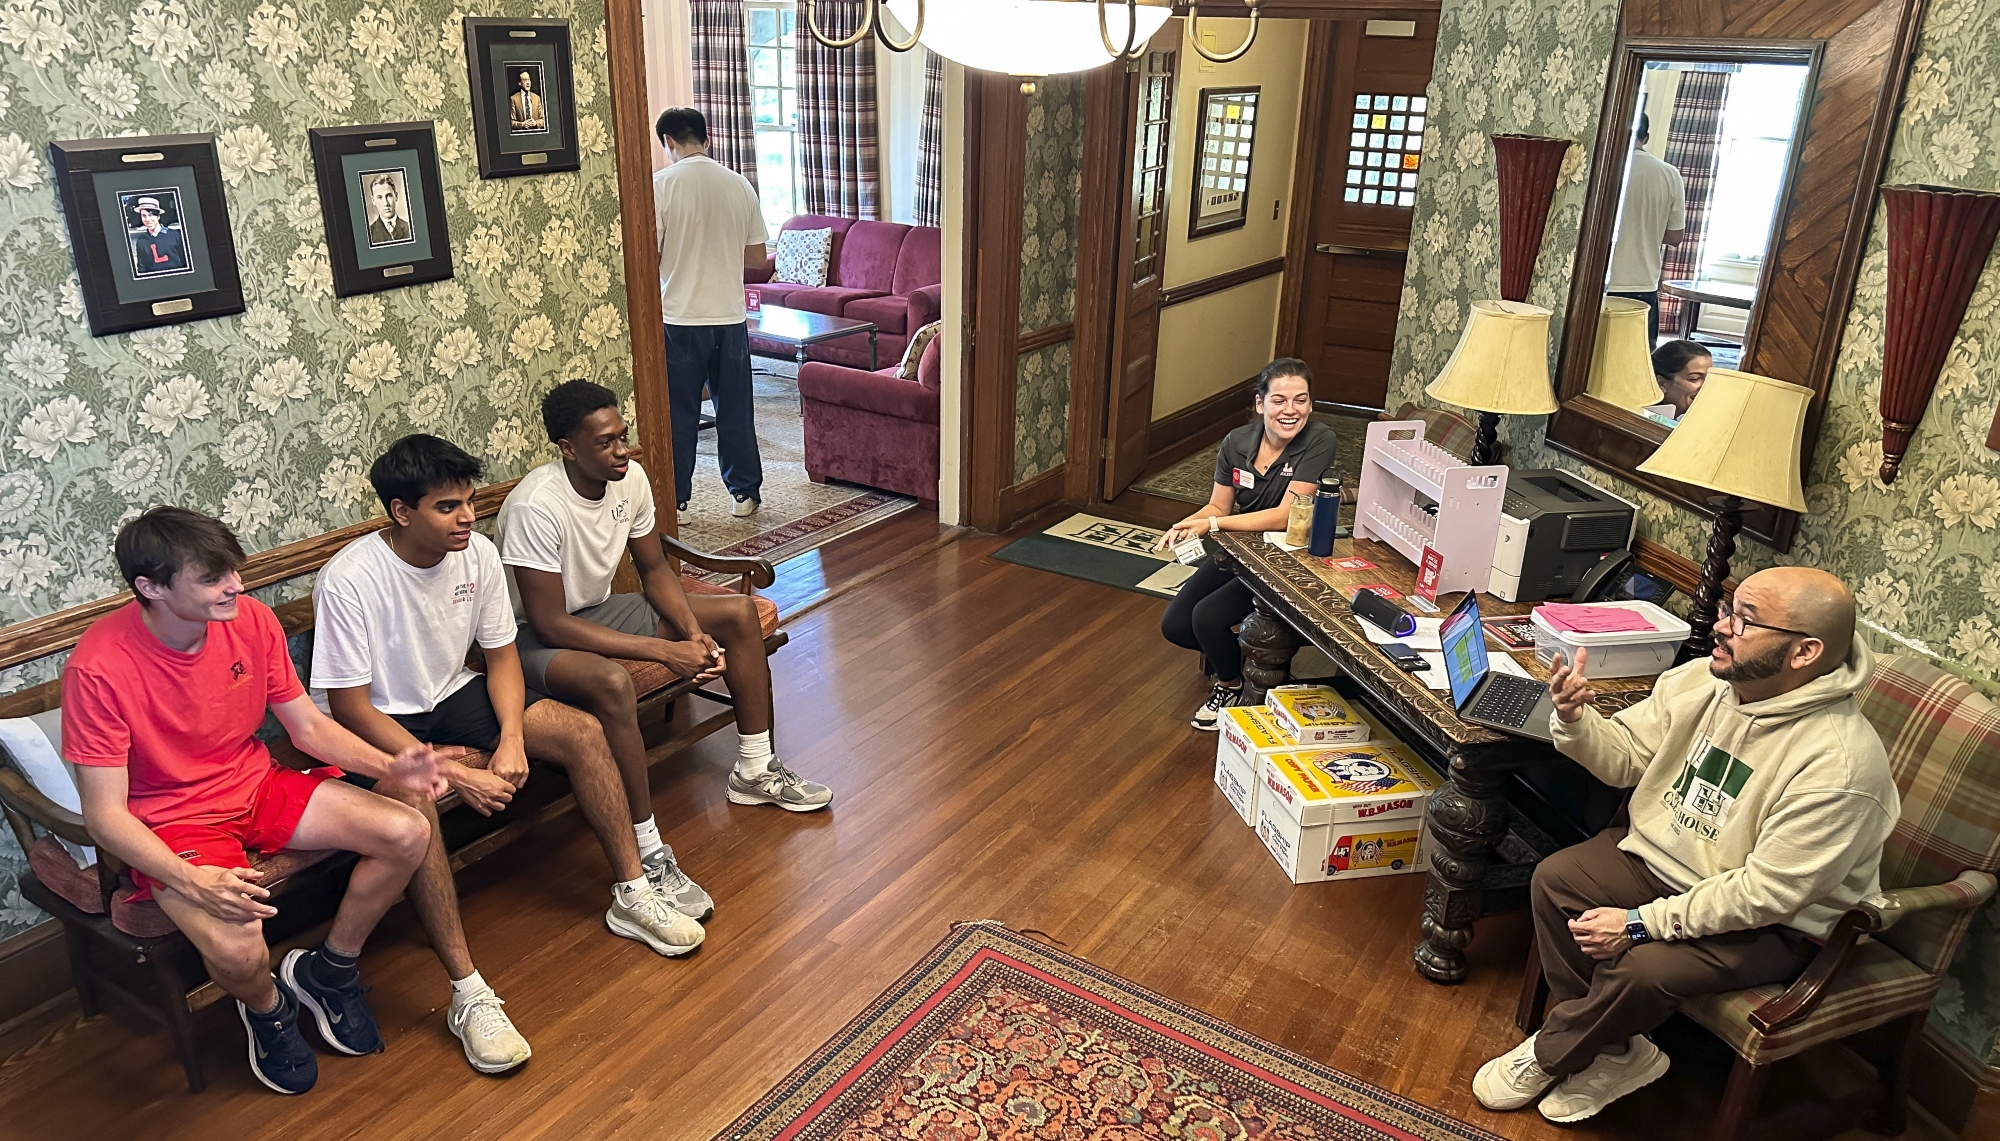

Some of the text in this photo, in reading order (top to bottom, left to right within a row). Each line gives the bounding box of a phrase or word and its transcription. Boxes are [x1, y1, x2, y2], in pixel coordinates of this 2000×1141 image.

[150, 243, 169, 263] L
[1242, 708, 1279, 745] FLAGSHIP
[1385, 747, 1432, 787] FLAGSHIP
[1358, 799, 1414, 818] W.B.MASON
